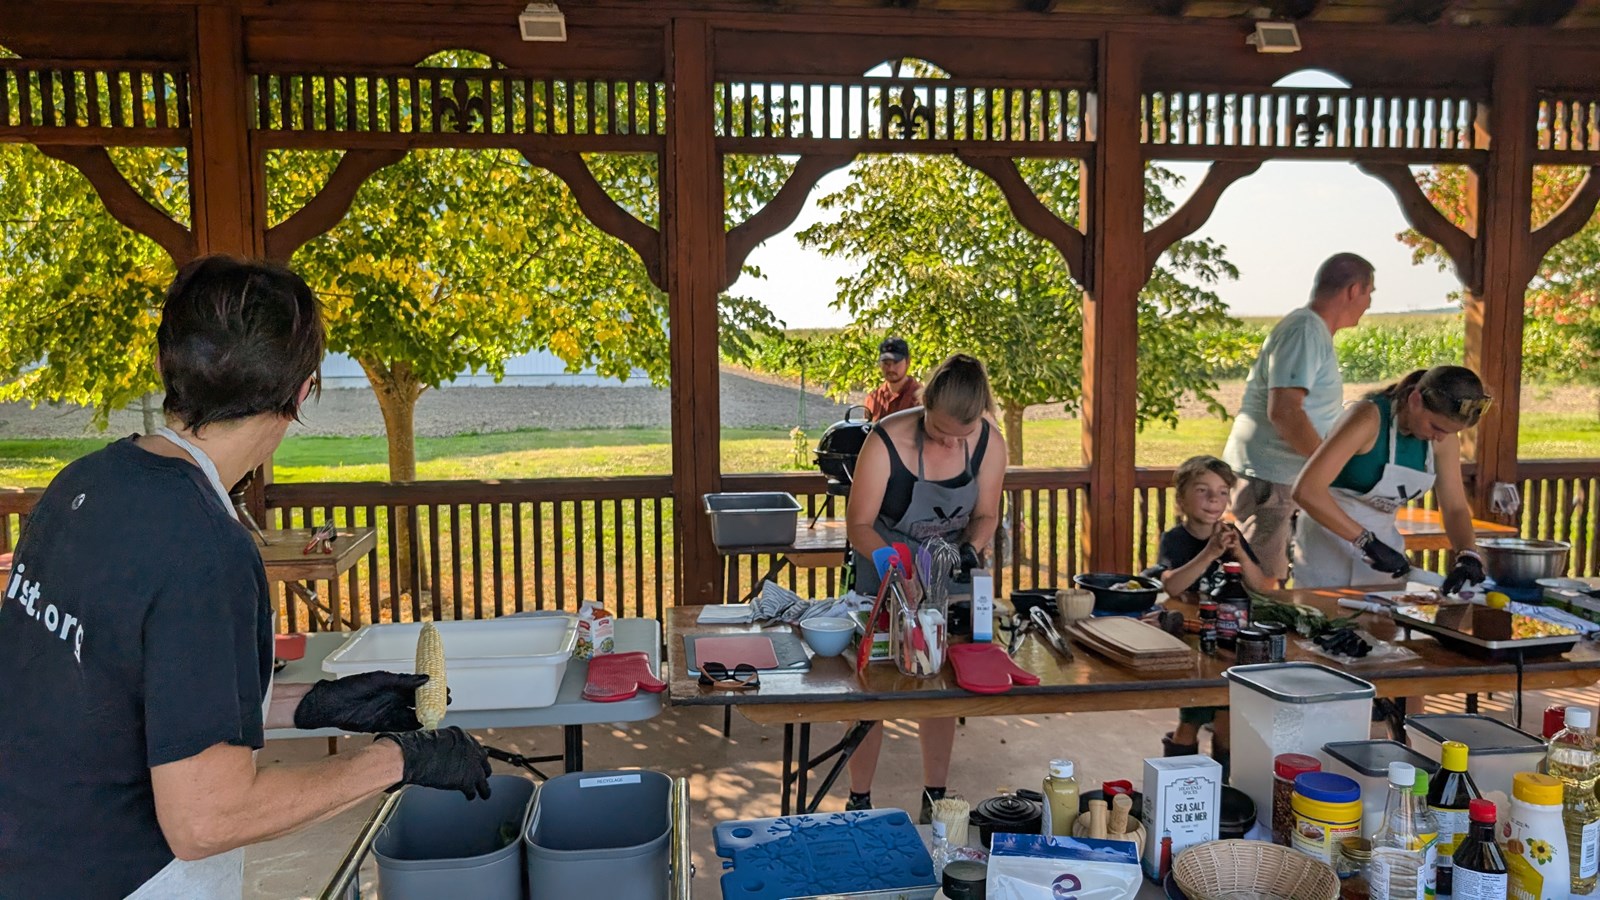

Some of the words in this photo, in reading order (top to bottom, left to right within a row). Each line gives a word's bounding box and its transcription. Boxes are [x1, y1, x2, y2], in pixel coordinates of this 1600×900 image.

[1175, 803, 1187, 812] SEA
[1189, 801, 1205, 812] SALT
[1172, 814, 1183, 823] SEL
[1185, 813, 1193, 822] DE
[1194, 811, 1207, 821] MER
